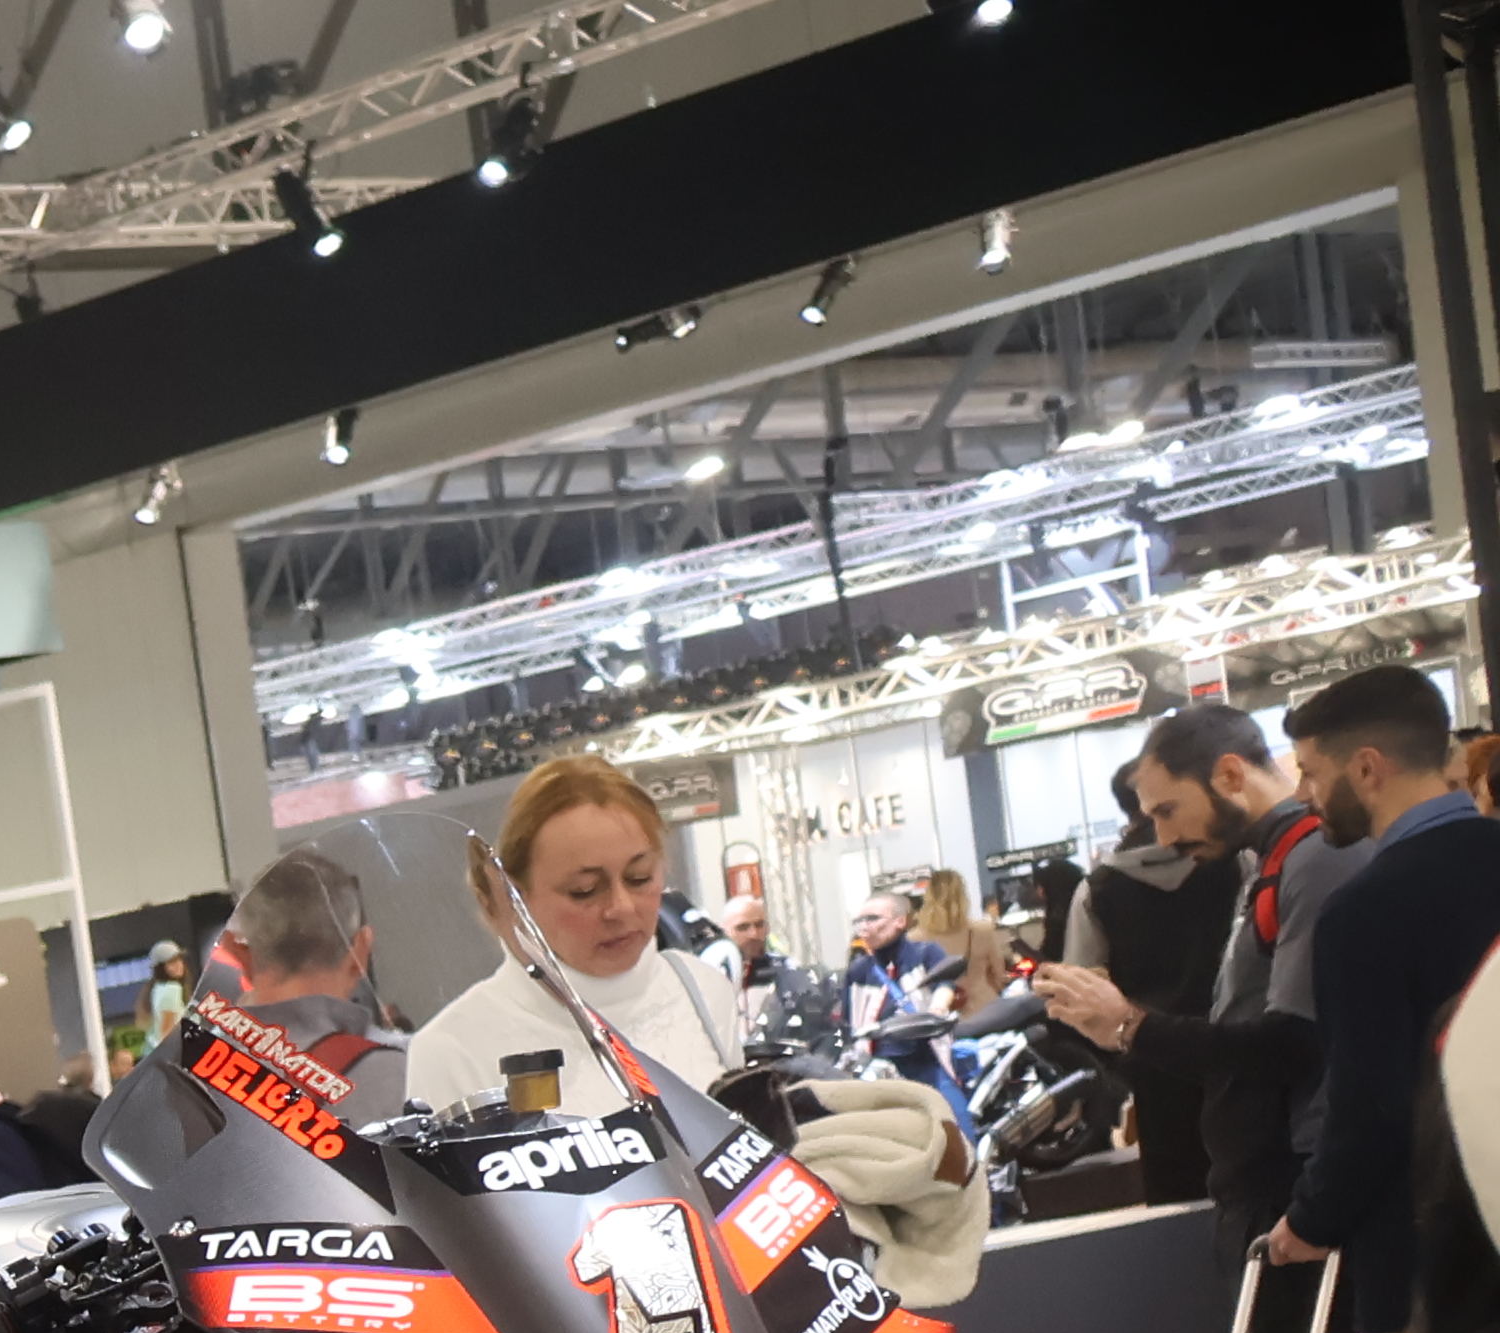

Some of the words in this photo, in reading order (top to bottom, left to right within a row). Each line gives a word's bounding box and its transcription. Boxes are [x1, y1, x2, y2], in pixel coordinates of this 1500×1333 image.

[478, 1119, 655, 1192] aprilia
[703, 1130, 773, 1191] TARGA
[734, 1167, 816, 1254] BS
[200, 1228, 394, 1261] TARGA
[229, 1274, 414, 1318] BS
[842, 1273, 874, 1310] PLAY
[226, 1313, 412, 1331] BATTERY
